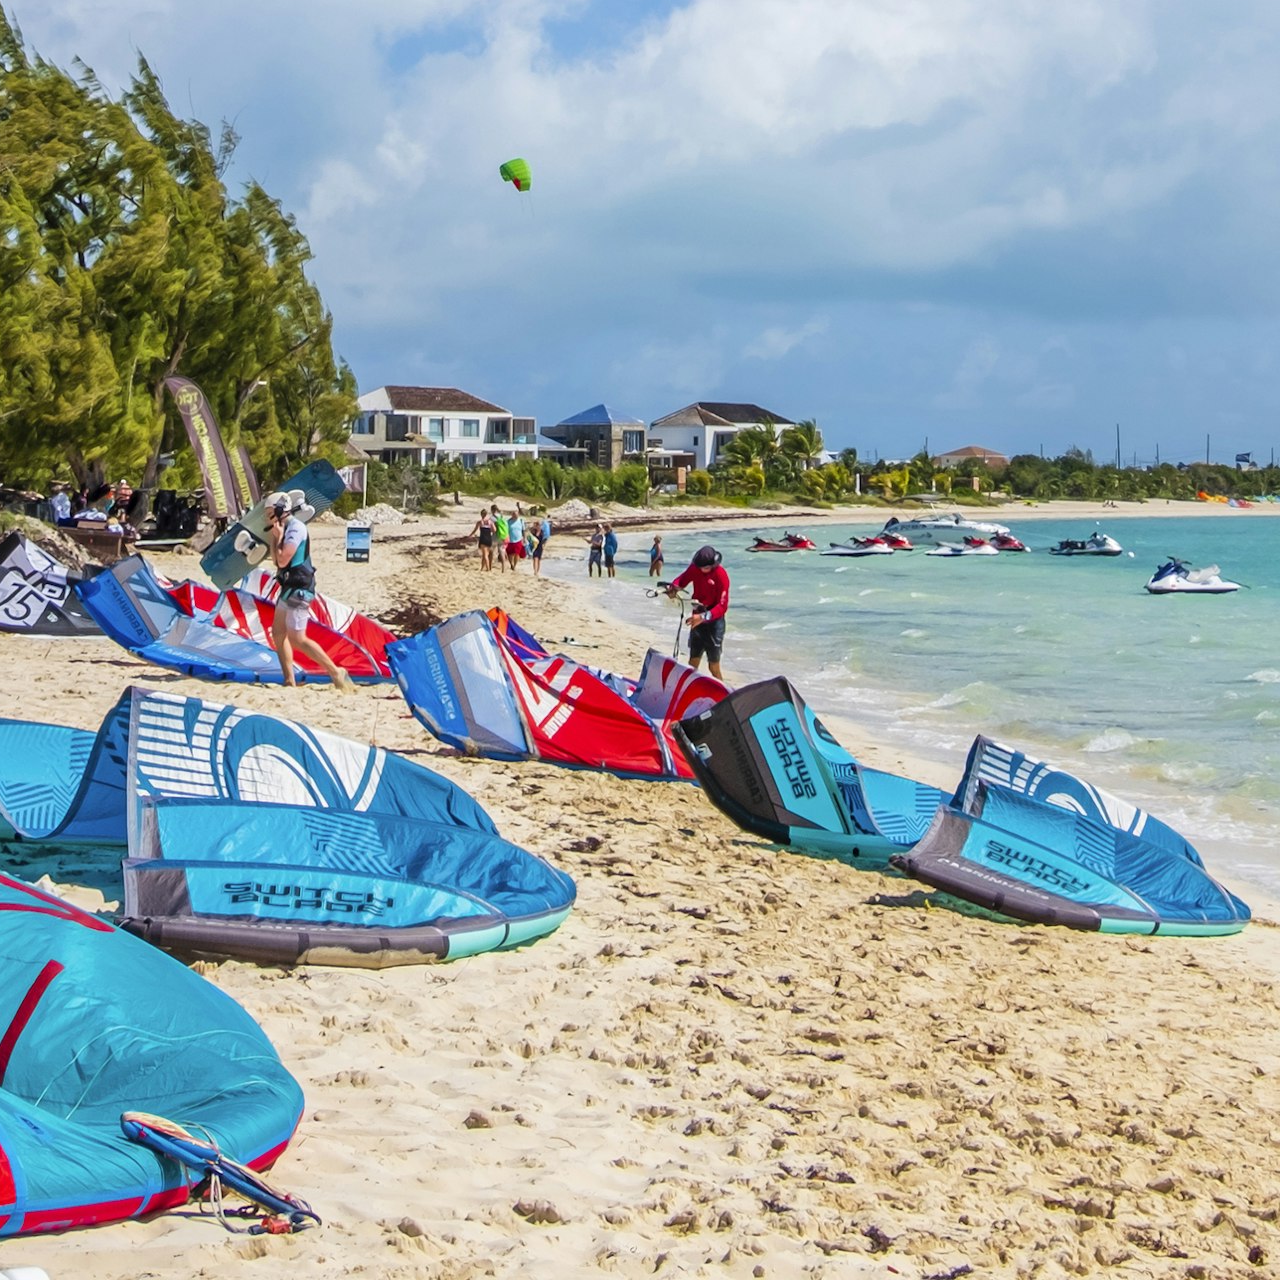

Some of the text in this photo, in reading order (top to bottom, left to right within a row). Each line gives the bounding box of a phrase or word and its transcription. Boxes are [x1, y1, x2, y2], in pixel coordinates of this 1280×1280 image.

[986, 839, 1090, 890] SWITCH
[986, 851, 1079, 894] BLADE
[223, 881, 395, 908] SWITCH
[231, 893, 384, 917] BLADE
